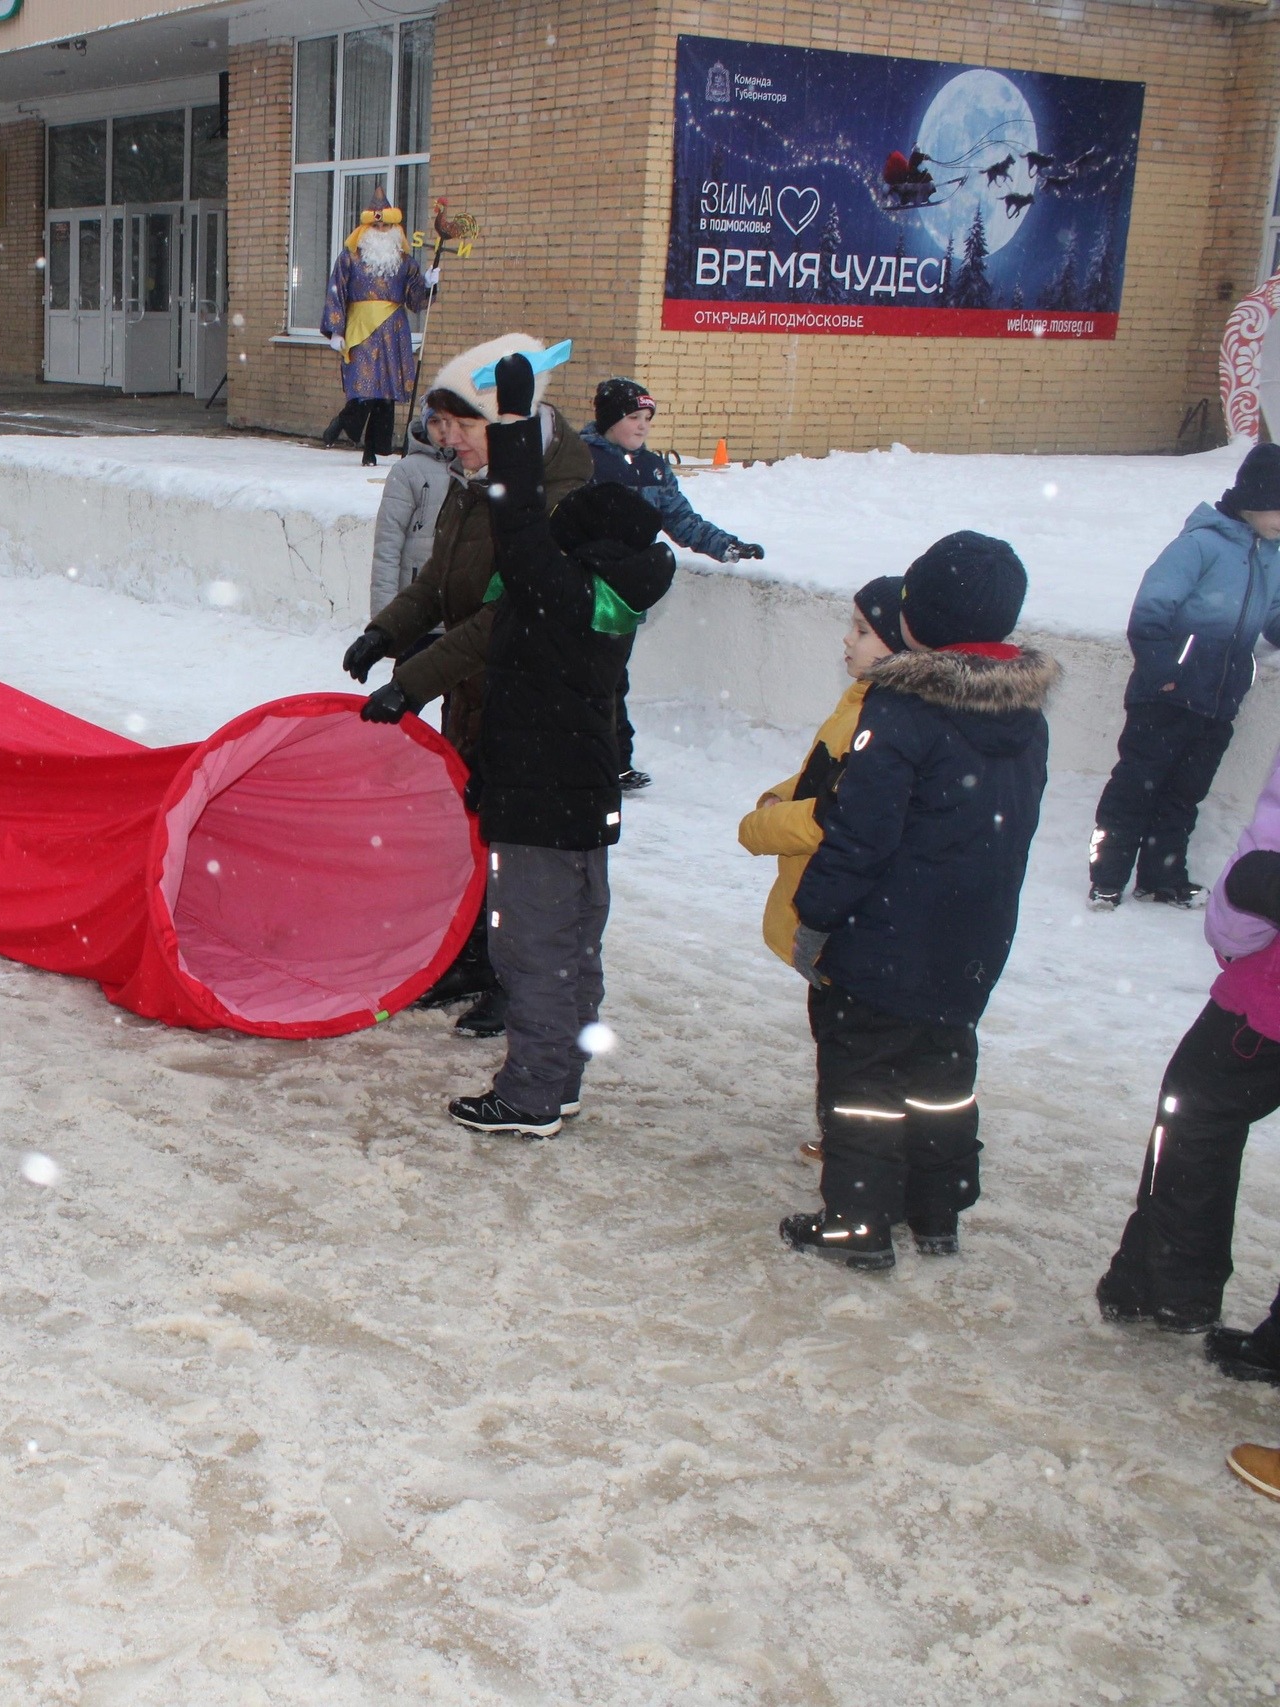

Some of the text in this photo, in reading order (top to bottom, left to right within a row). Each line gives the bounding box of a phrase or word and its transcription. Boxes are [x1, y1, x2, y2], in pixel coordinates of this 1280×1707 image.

[734, 73, 772, 88] Команда
[735, 88, 787, 104] Губернатора
[696, 247, 947, 297] ВРЕМЯ ЧУДЕС!
[694, 310, 864, 328] ОТКРЫВАЙ ПОДМОСКОВЬЕ
[1007, 314, 1094, 337] welcome.mosreg.ru
